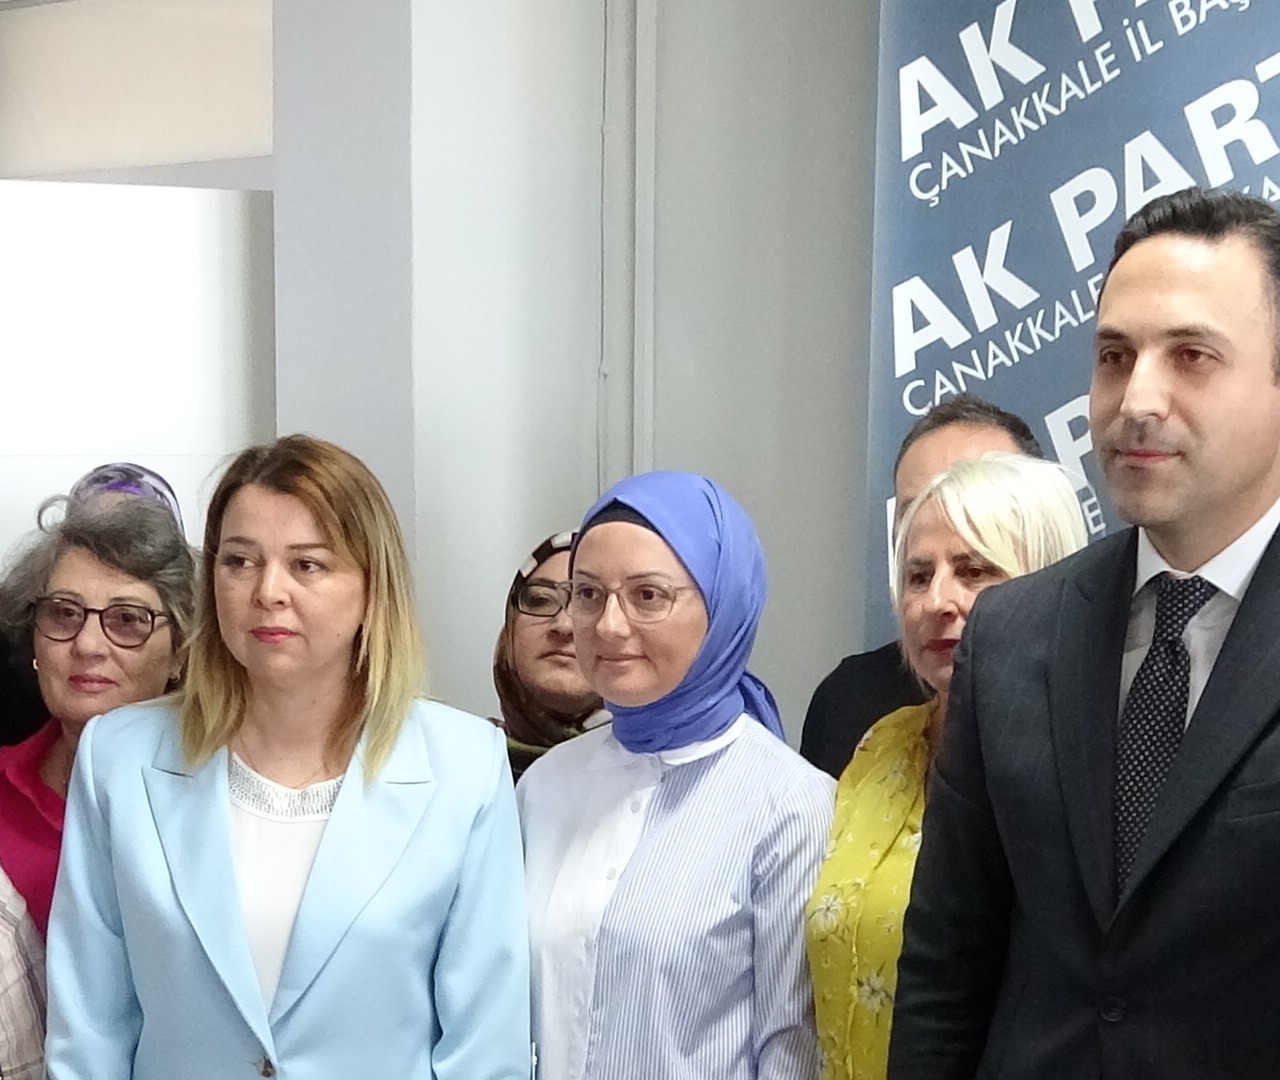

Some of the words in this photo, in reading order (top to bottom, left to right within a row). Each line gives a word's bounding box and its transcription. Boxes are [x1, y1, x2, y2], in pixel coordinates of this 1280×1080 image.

[899, 0, 1047, 163] AK
[908, 40, 1121, 208] ÇANAKKALE
[1123, 18, 1164, 63] İL
[892, 220, 1041, 379] AK
